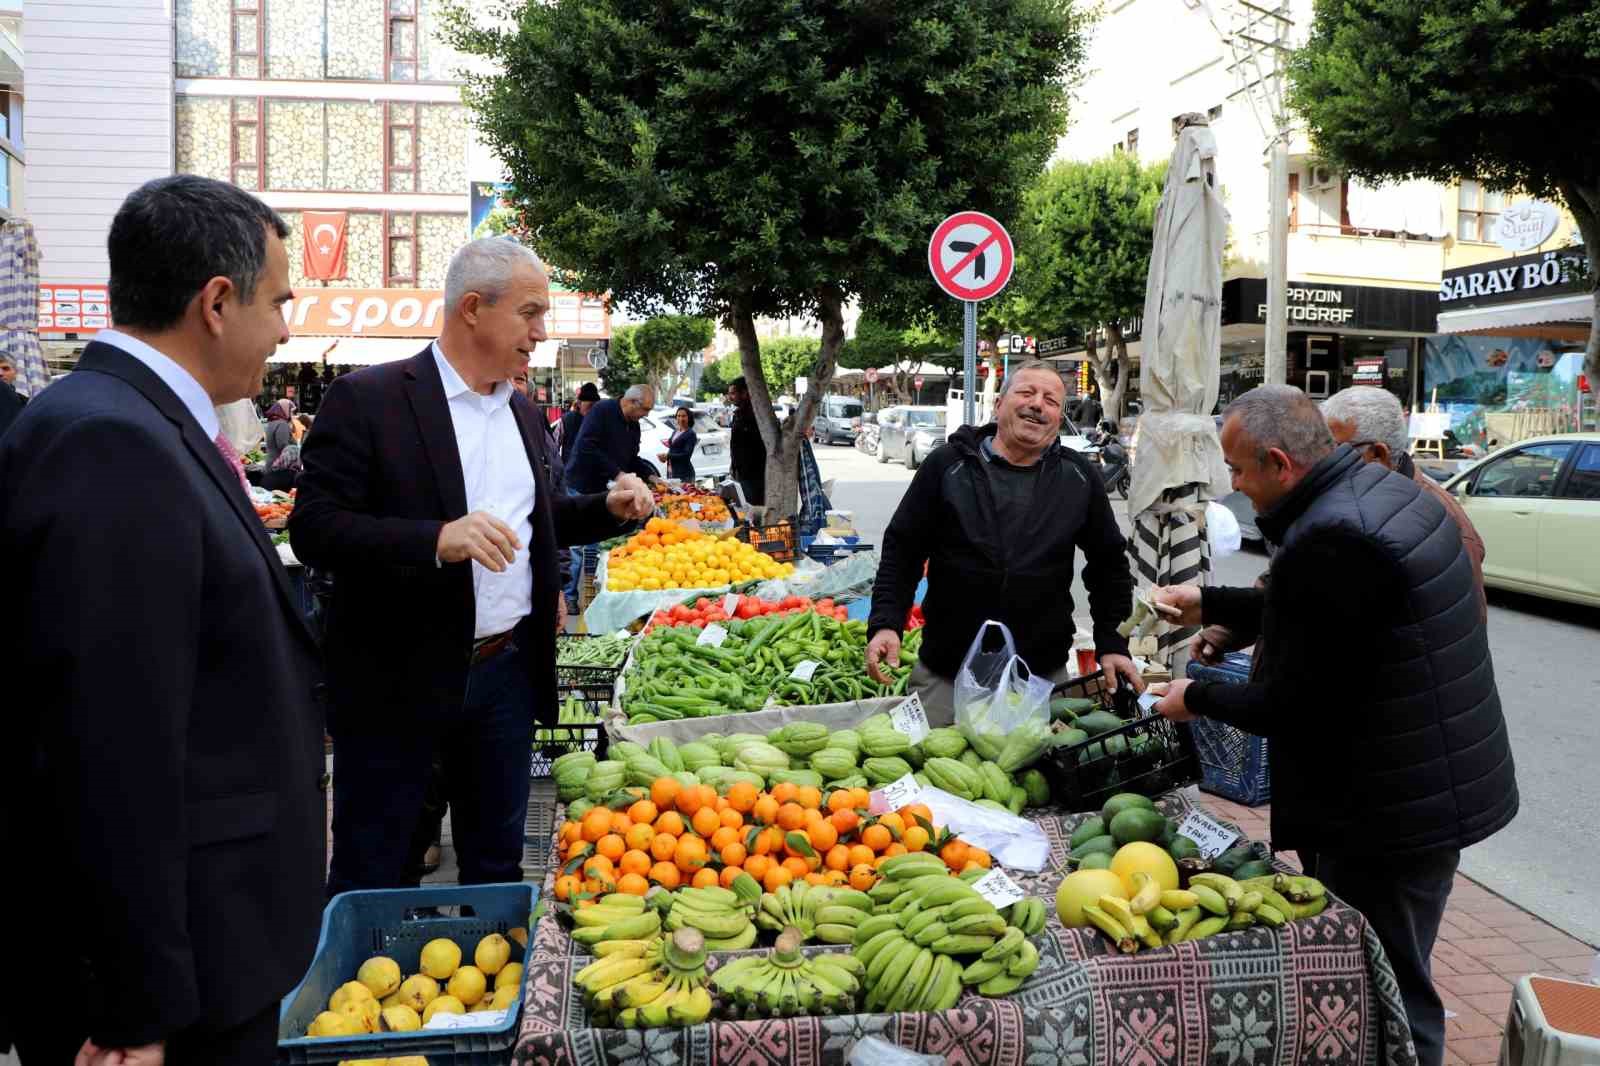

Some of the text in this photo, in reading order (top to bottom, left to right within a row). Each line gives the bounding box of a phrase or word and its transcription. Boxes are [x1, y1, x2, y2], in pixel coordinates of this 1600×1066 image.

[1439, 266, 1519, 301] SARAY
[327, 295, 446, 333] spor
[1258, 304, 1354, 322] FTOĞRAF
